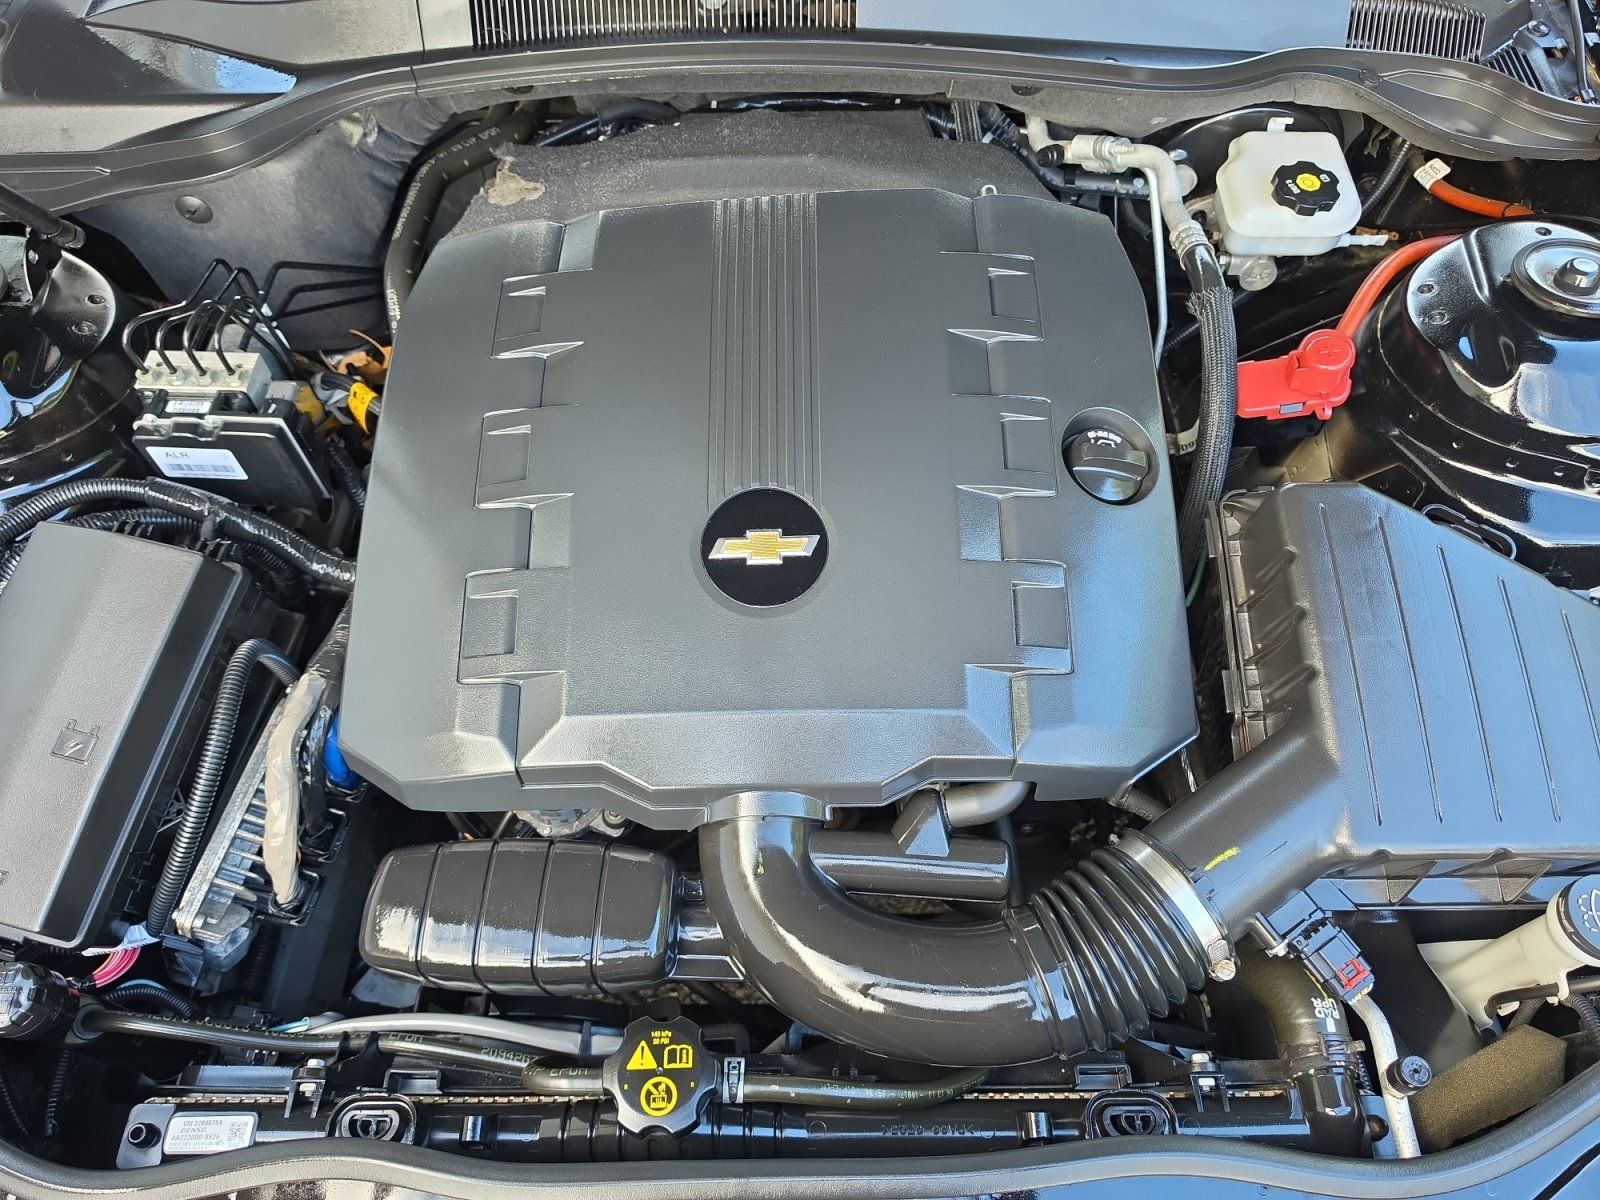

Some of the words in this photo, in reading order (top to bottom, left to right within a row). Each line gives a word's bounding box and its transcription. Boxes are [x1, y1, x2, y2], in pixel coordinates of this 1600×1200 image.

[1310, 997, 1338, 1009] UPR
[1314, 1007, 1340, 1019] RAD
[481, 1047, 541, 1065] 2094267
